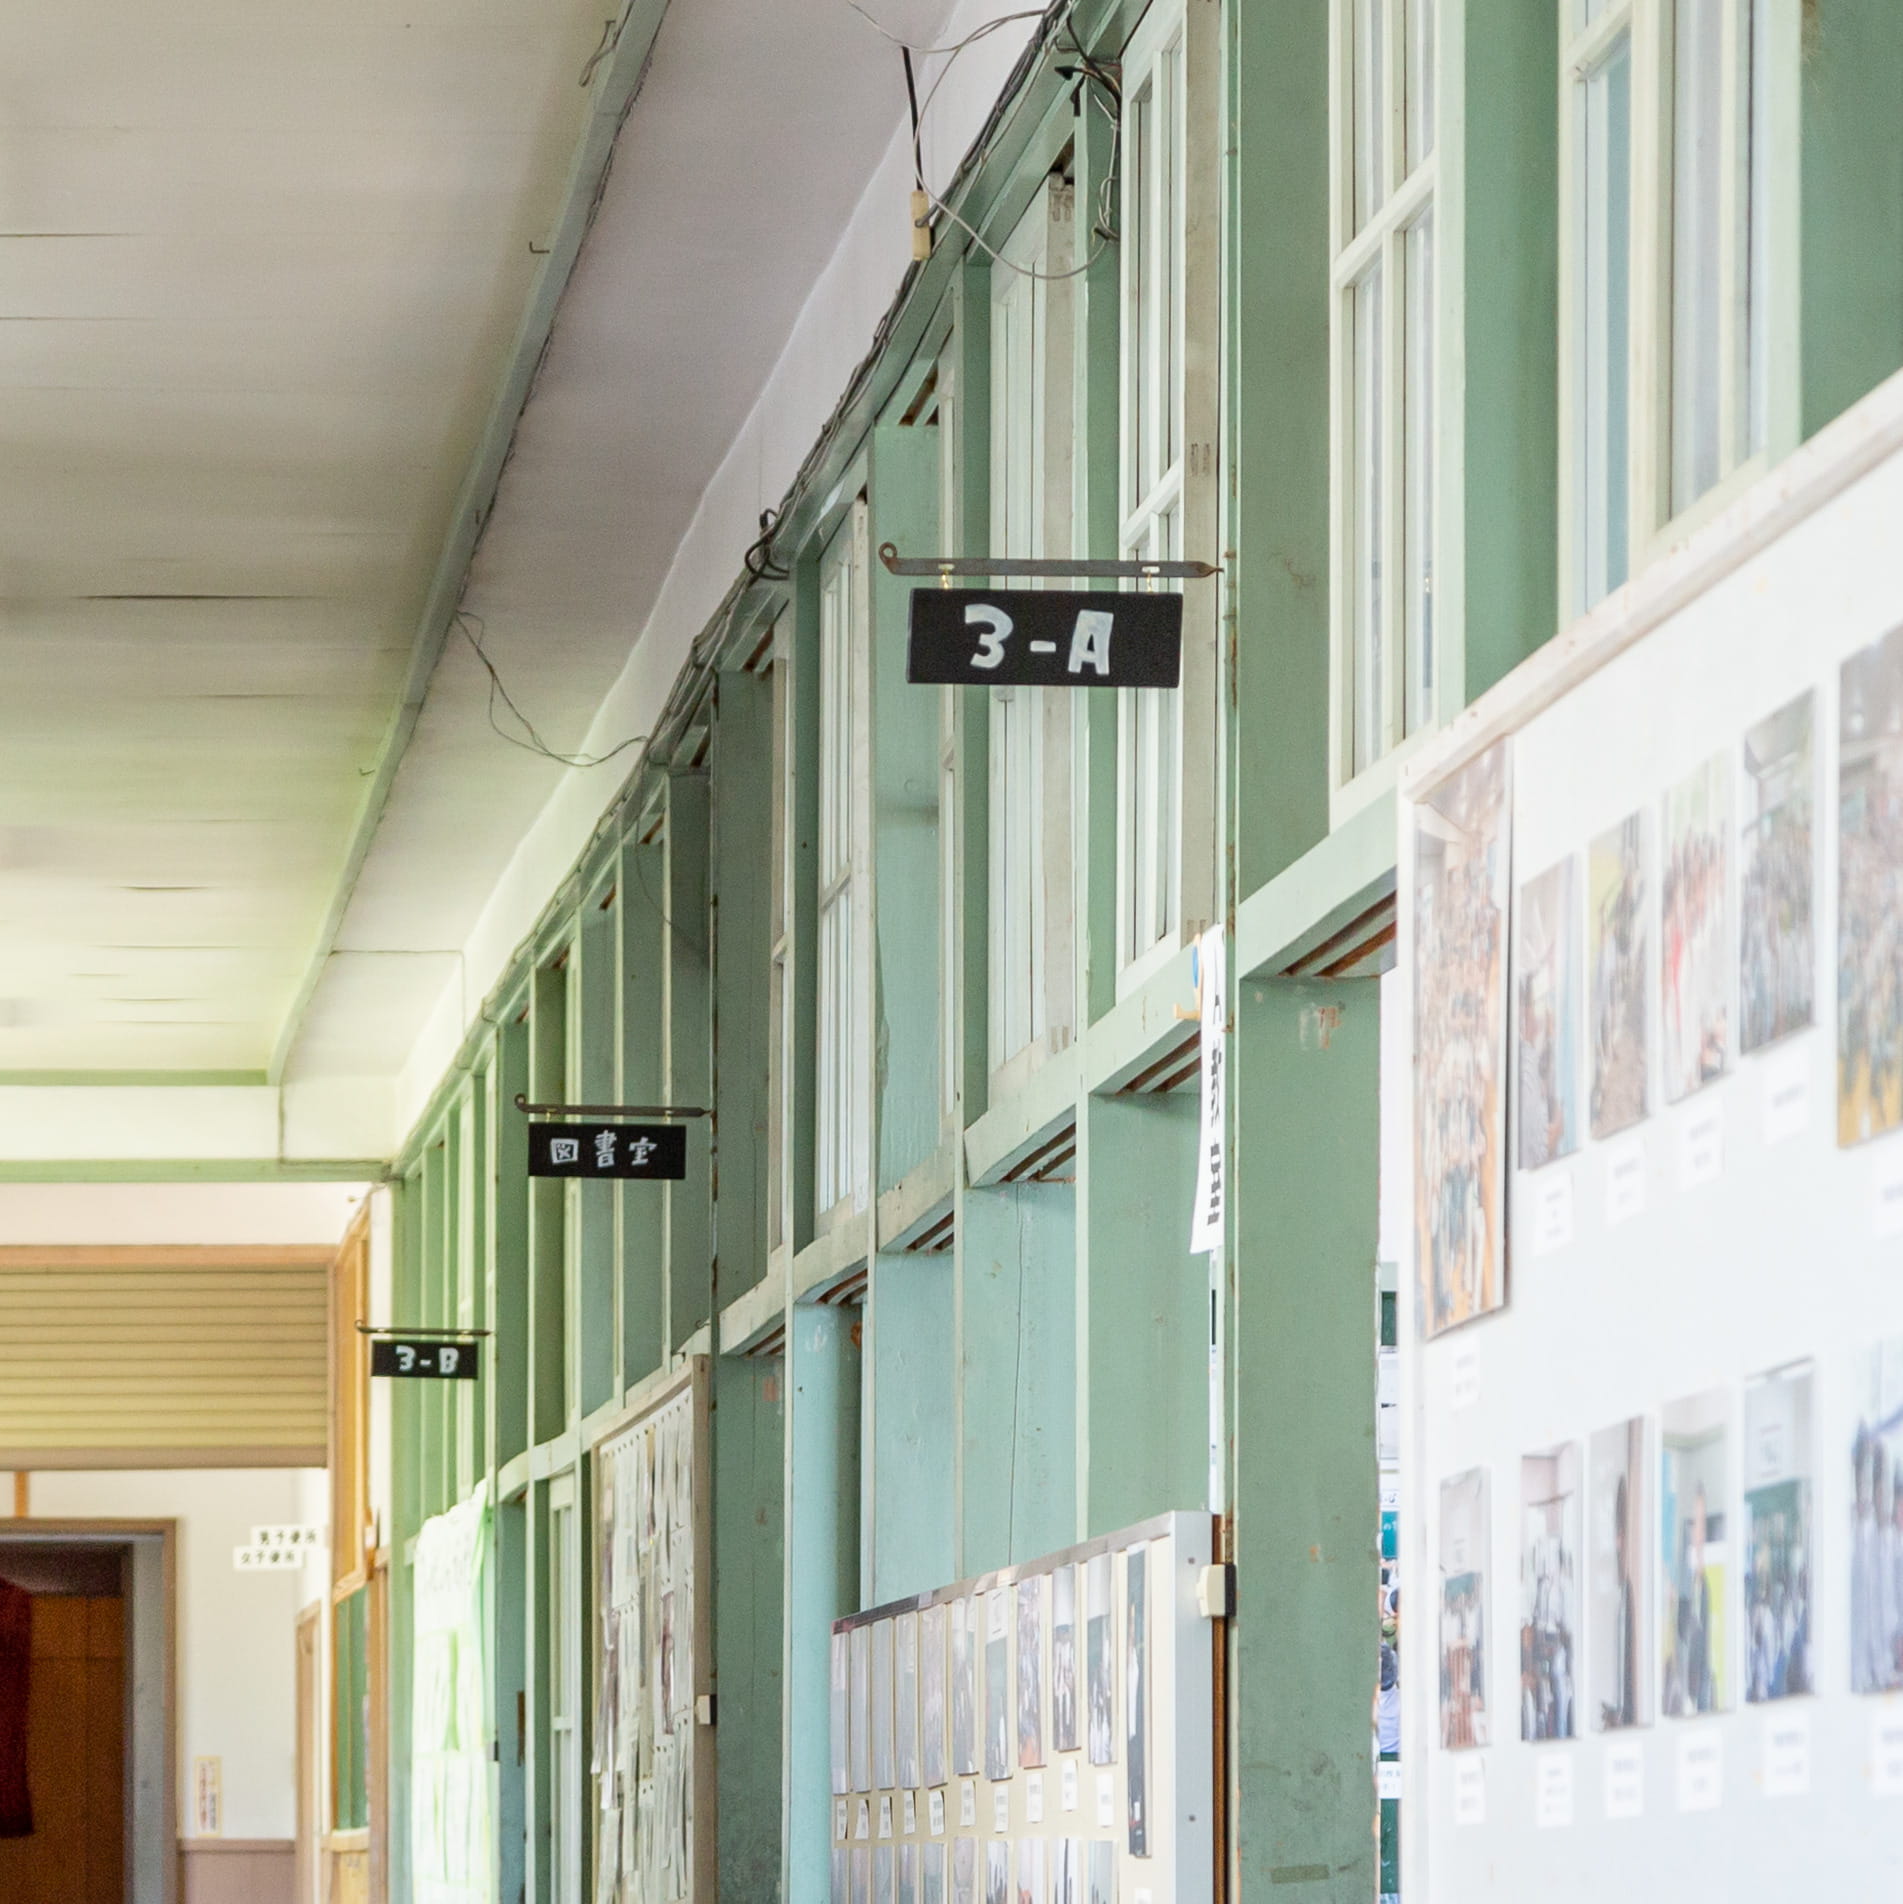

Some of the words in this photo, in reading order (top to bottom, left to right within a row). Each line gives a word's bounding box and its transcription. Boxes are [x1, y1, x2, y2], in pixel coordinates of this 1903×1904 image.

[964, 602, 1114, 676] 3-A
[549, 1129, 658, 1169] 図書室
[395, 1345, 460, 1375] 3-B
